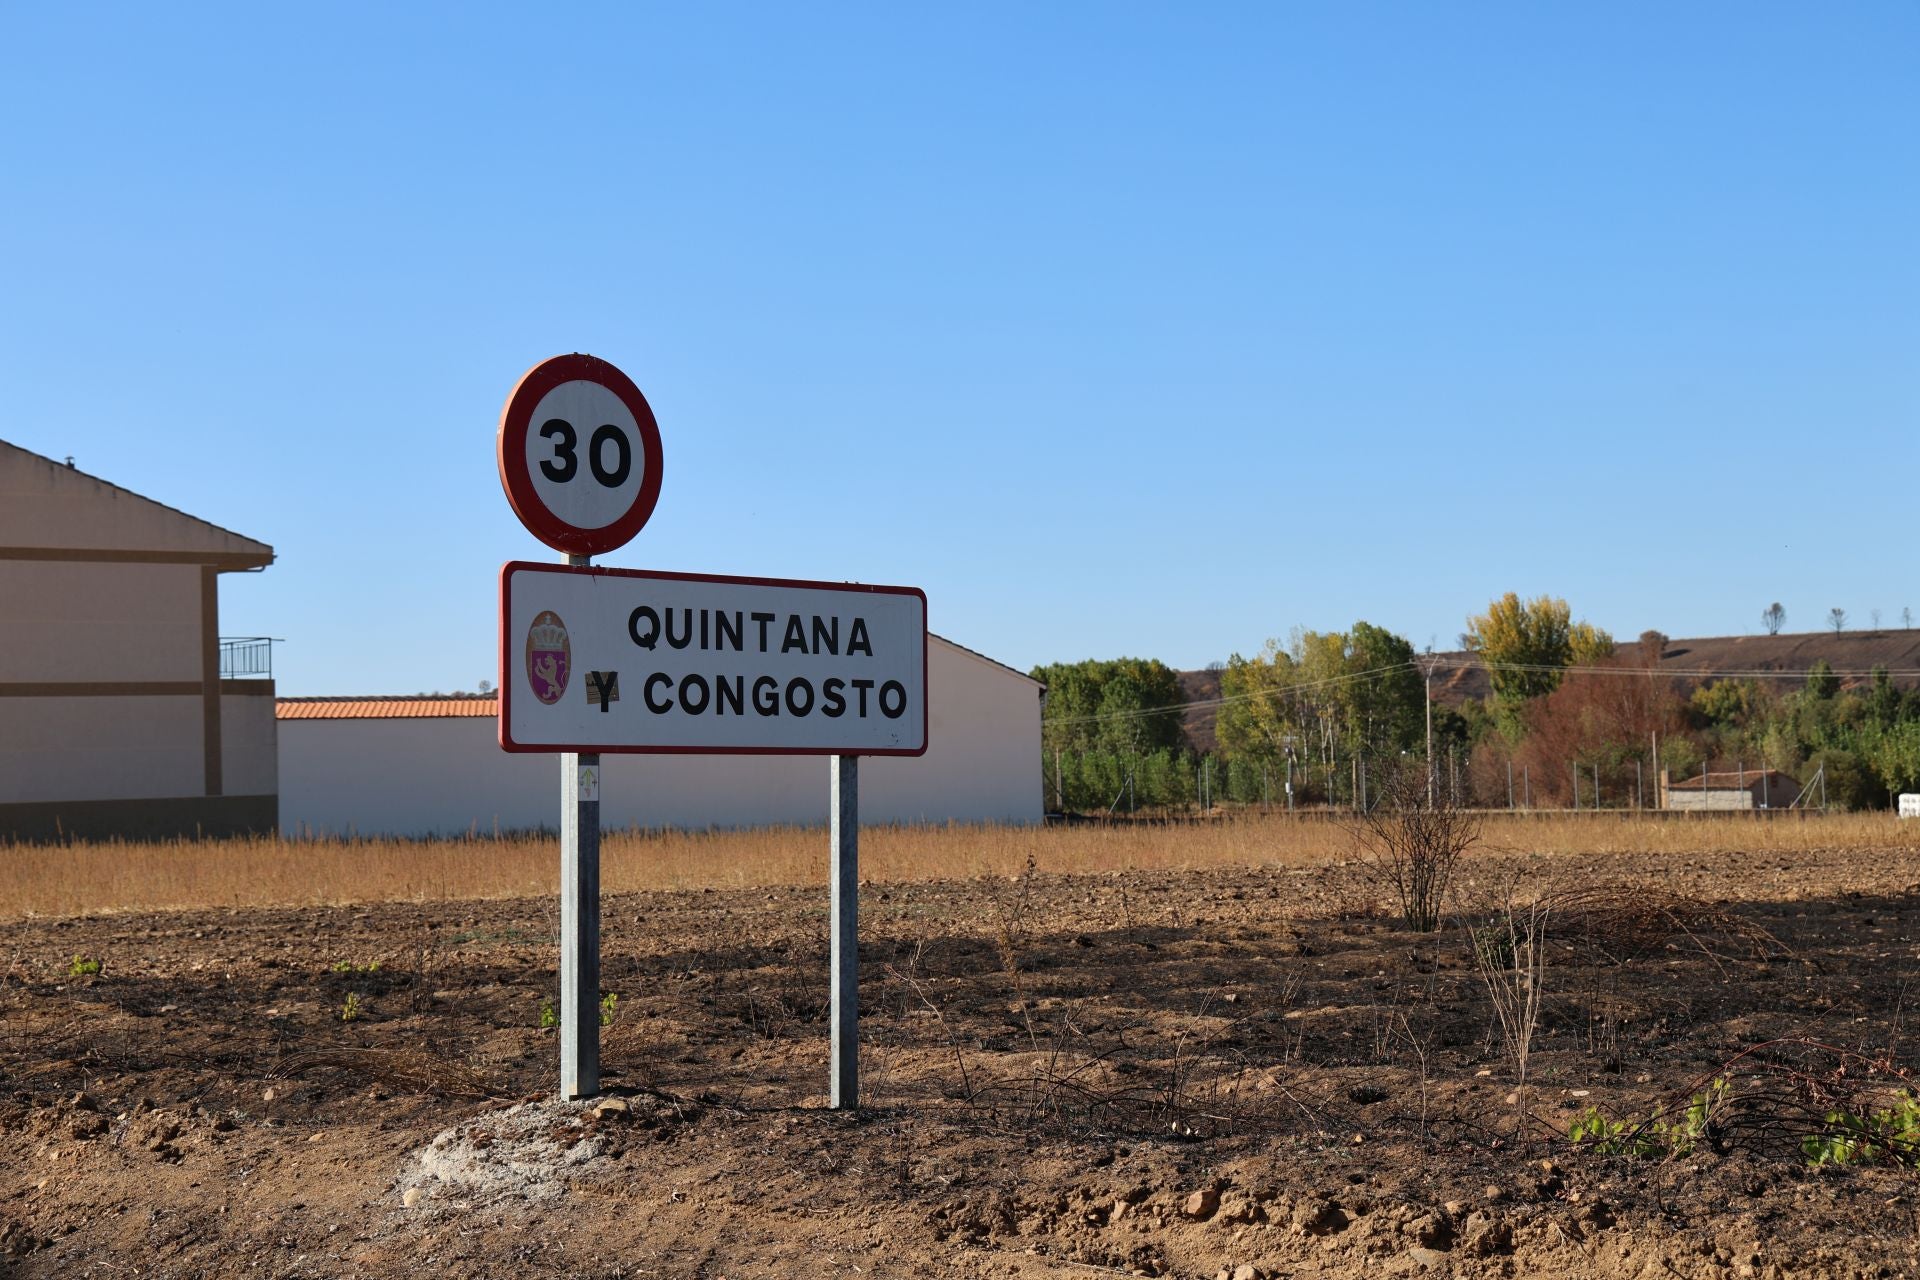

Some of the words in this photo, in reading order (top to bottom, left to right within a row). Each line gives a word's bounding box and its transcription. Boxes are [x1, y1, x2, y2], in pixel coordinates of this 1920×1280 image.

[538, 418, 632, 489] 30
[627, 605, 874, 658] QUINTANA
[590, 671, 619, 713] Y
[643, 671, 908, 720] CONGOSTO
